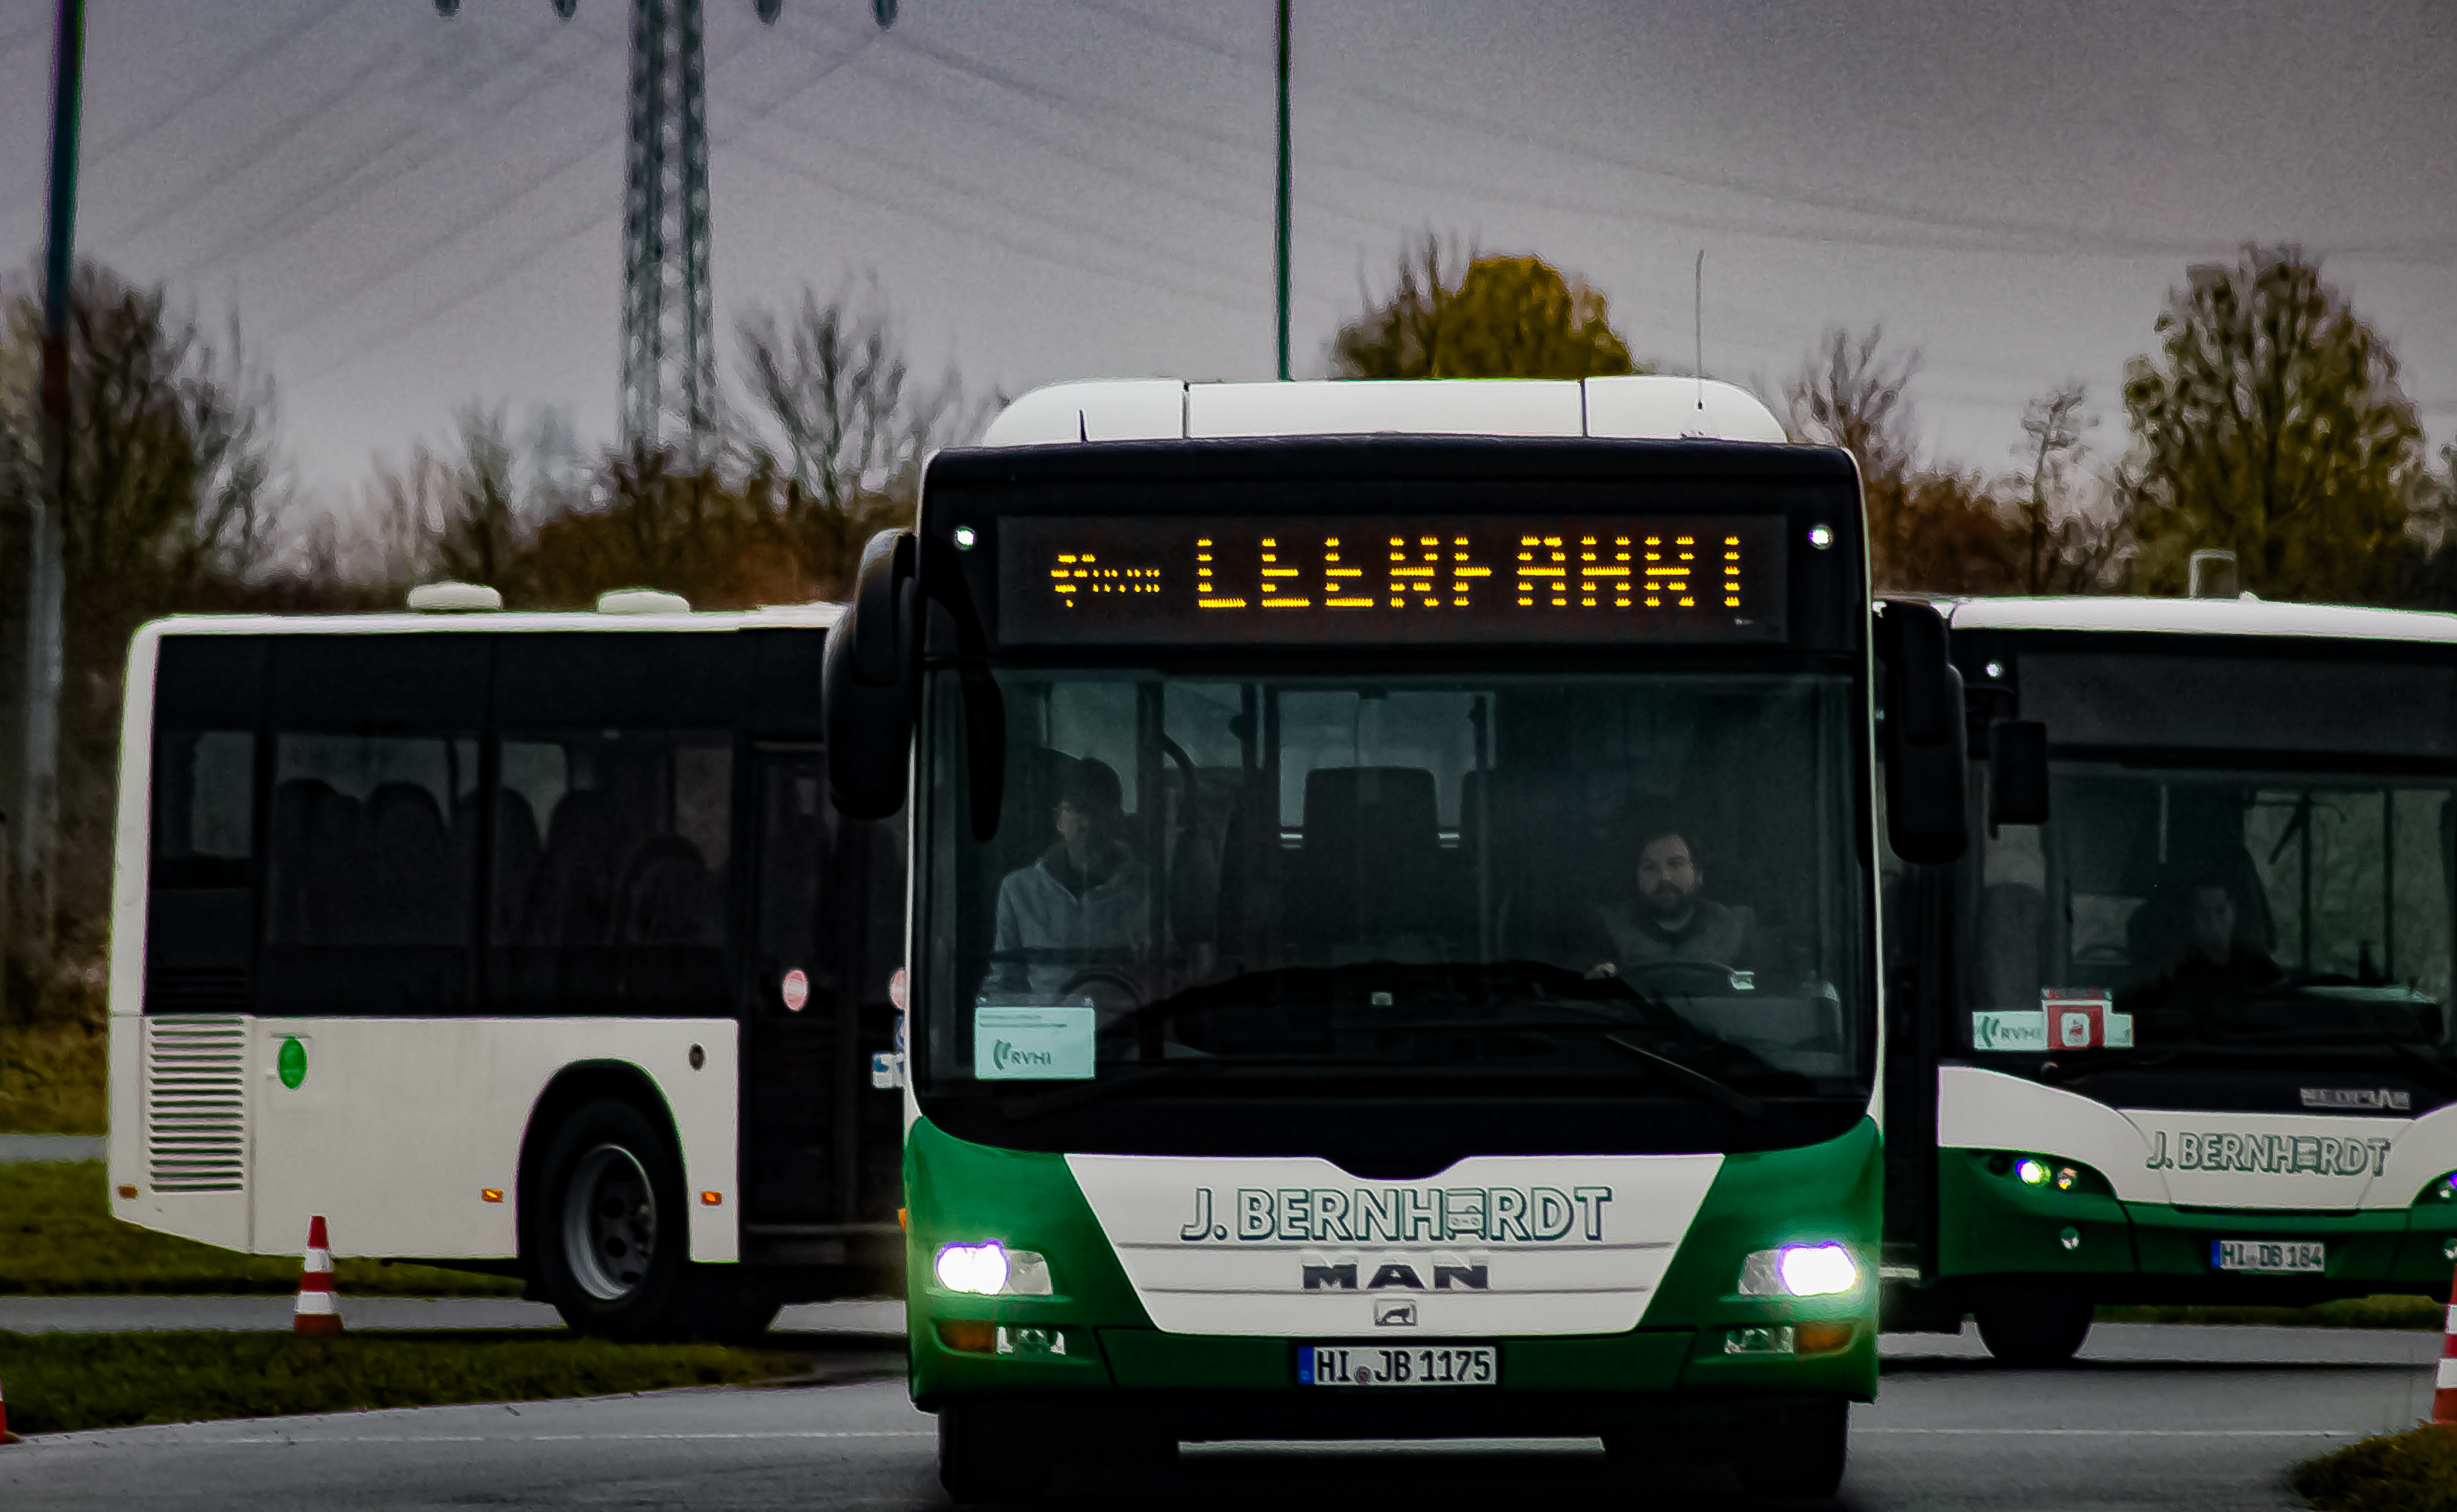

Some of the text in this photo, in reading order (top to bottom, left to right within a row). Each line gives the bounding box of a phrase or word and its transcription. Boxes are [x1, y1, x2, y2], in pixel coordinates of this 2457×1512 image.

[2146, 1131, 2174, 1170] J.
[1180, 1187, 1228, 1241] J.
[1302, 1262, 1490, 1291] MAN
[1317, 1350, 1490, 1383] HI JB 1175
